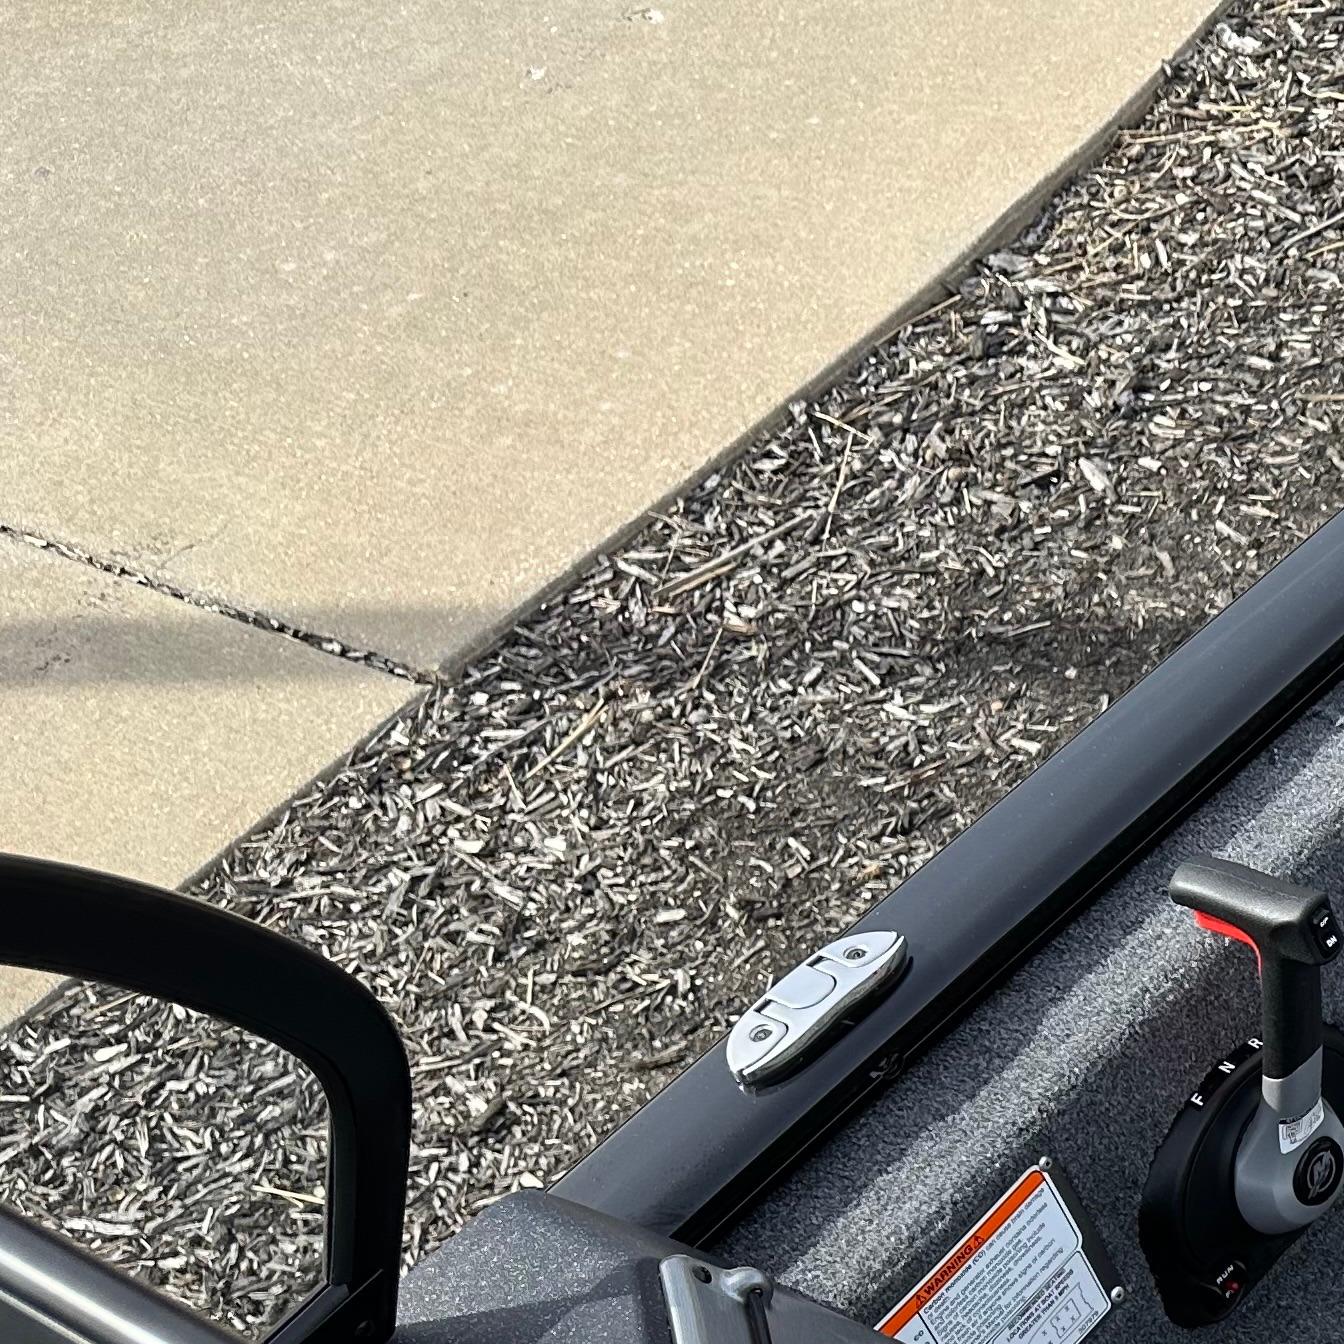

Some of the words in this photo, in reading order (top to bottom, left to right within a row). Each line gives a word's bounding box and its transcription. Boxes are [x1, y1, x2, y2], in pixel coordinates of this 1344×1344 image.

[1326, 935, 1337, 947] DN
[1218, 1061, 1236, 1073] N
[1248, 1038, 1263, 1049] R
[1191, 1092, 1204, 1106] F
[923, 1290, 945, 1315] Carbon
[944, 1262, 972, 1293] monoxide
[971, 1248, 987, 1267] (CO)
[985, 1238, 996, 1251] can
[995, 1221, 1012, 1241] cause
[1010, 1207, 1024, 1224] brain
[1024, 1186, 1045, 1211] damage
[924, 1242, 973, 1297] WARNING
[930, 1304, 950, 1326] Engine
[949, 1292, 961, 1307] and
[960, 1267, 985, 1296] generator
[984, 1246, 1005, 1270] exhaust
[1004, 1223, 1027, 1248] contains
[952, 1311, 959, 1321] of
[958, 1293, 978, 1315] carbon
[977, 1266, 1003, 1295] monoxide
[1026, 1221, 1045, 1243] include
[982, 1294, 1002, 1317] anyone
[1001, 1276, 1018, 1296] shows
[1017, 1261, 1033, 1279] signs
[1030, 1255, 1038, 1264] of
[1037, 1237, 1055, 1258] carbon
[1217, 1265, 1234, 1284] RUN
[934, 1318, 945, 1331] and
[967, 1273, 987, 1296] carbon
[986, 1247, 1012, 1276] monoxide
[985, 1307, 1005, 1330] Manual
[1004, 1299, 1012, 1310] for
[1038, 1245, 1064, 1274] regarding
[1006, 1310, 1035, 1342] LOCATIONS
[1034, 1303, 1041, 1312] AT
[1040, 1289, 1054, 1305] BOAT
[1054, 1268, 1074, 1290] SPEEDS
[1018, 1312, 1042, 1339] GREATER
[1041, 1298, 1055, 1315] THAN
[1057, 1283, 1069, 1297] MPH
[965, 1315, 973, 1324] of
